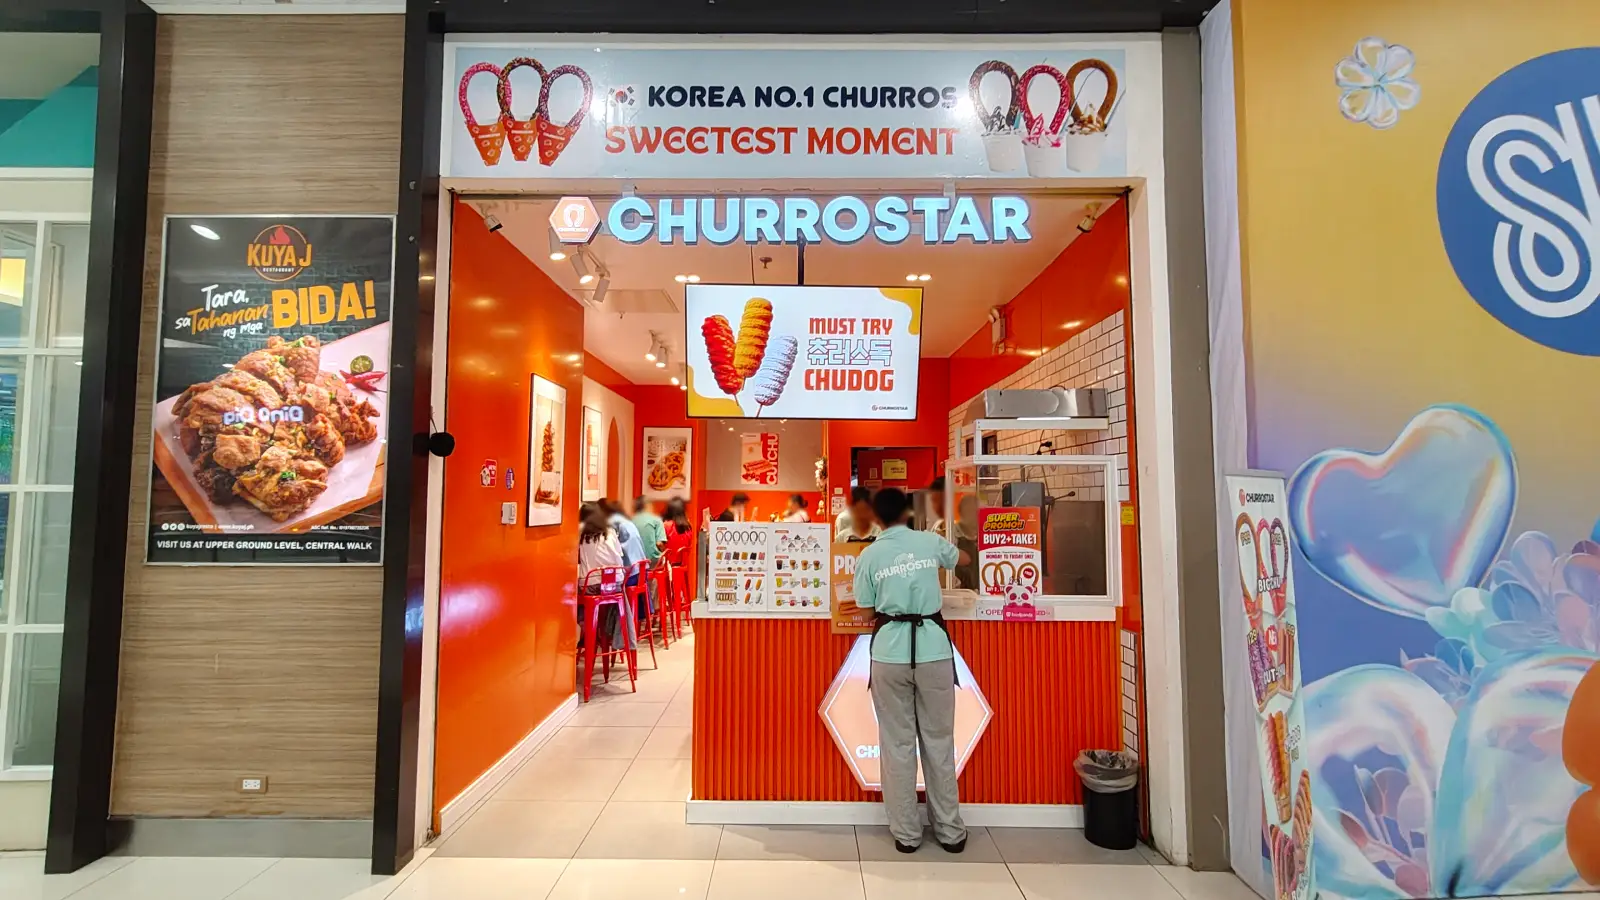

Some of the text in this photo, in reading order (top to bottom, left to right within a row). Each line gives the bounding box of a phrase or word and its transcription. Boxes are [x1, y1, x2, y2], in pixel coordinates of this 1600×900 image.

[648, 85, 957, 109] KOREA NO.1 CHURROS
[605, 126, 960, 155] SWEETEST MOMENT
[607, 195, 1032, 245] CHURROSTAR
[247, 243, 312, 267] KUYA J
[201, 284, 249, 312] Tara,
[271, 280, 377, 329] BIDA!
[175, 303, 268, 335] sa Tahanan
[809, 317, 893, 335] MUST TRY
[223, 328, 236, 341] ng
[807, 337, 892, 366] 츄러스독
[804, 369, 894, 392] CHUDOG
[984, 521, 1024, 531] PROMO!!
[987, 513, 1018, 523] SUPER
[157, 540, 372, 550] VISIT US AT UPPER GROUND LEVEL, CENTRAL WALK
[983, 533, 1036, 545] BUY2+TAKE1
[834, 554, 860, 575] PR
